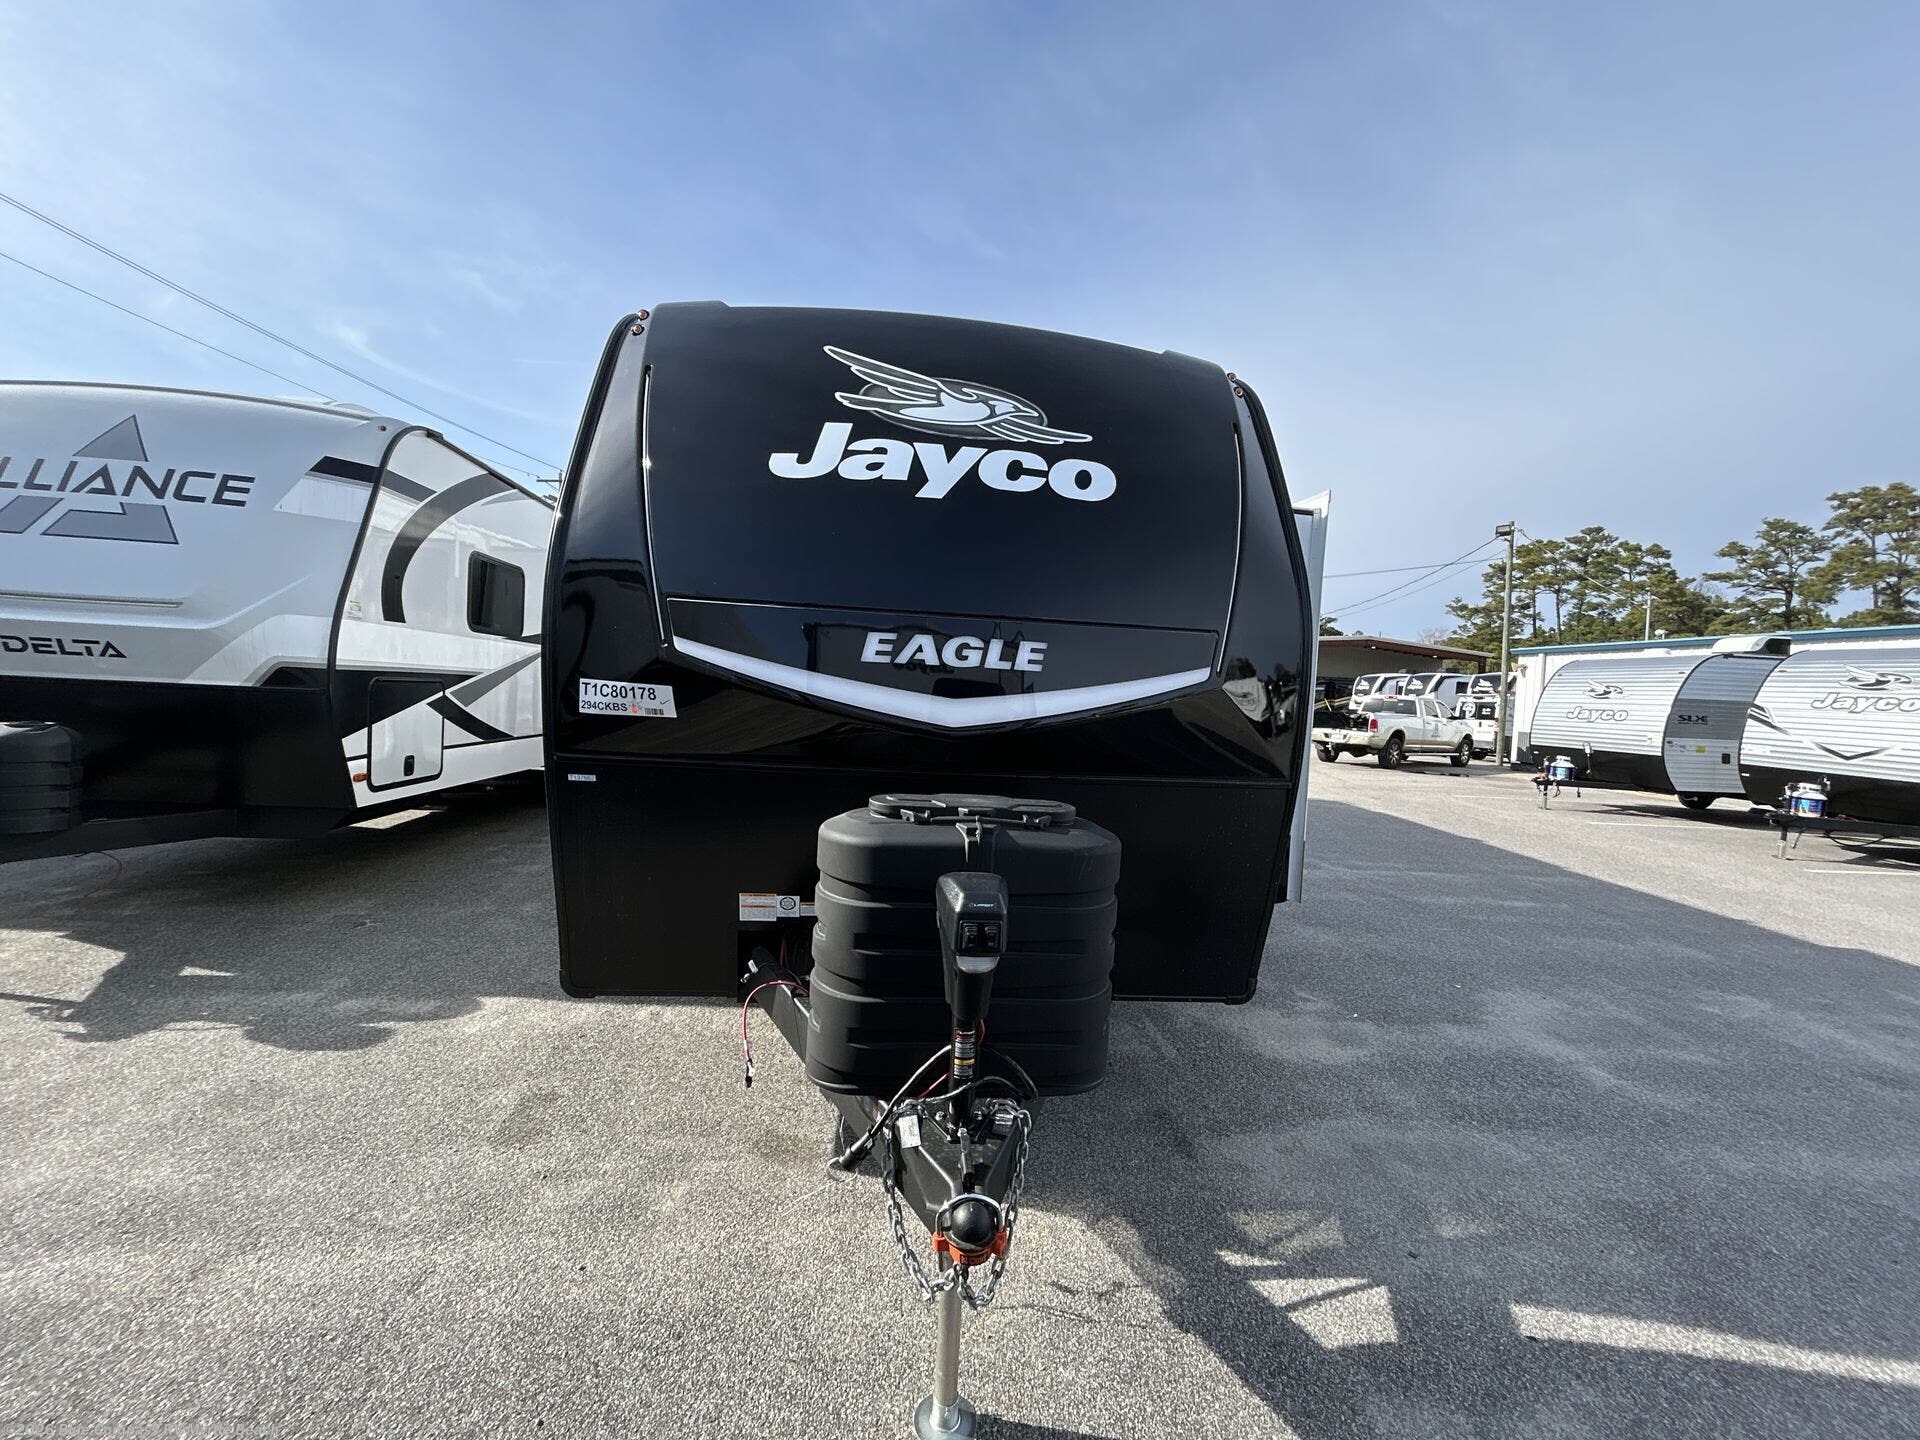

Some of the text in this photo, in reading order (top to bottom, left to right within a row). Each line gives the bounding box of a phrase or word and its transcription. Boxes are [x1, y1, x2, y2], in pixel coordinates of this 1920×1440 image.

[768, 422, 1117, 502] Jayco
[860, 631, 1049, 672] EAGLE
[581, 682, 657, 701] T1C80178
[580, 700, 628, 712] 294CKBS
[1811, 691, 1920, 714] Jayco
[1566, 706, 1629, 723] Jayco
